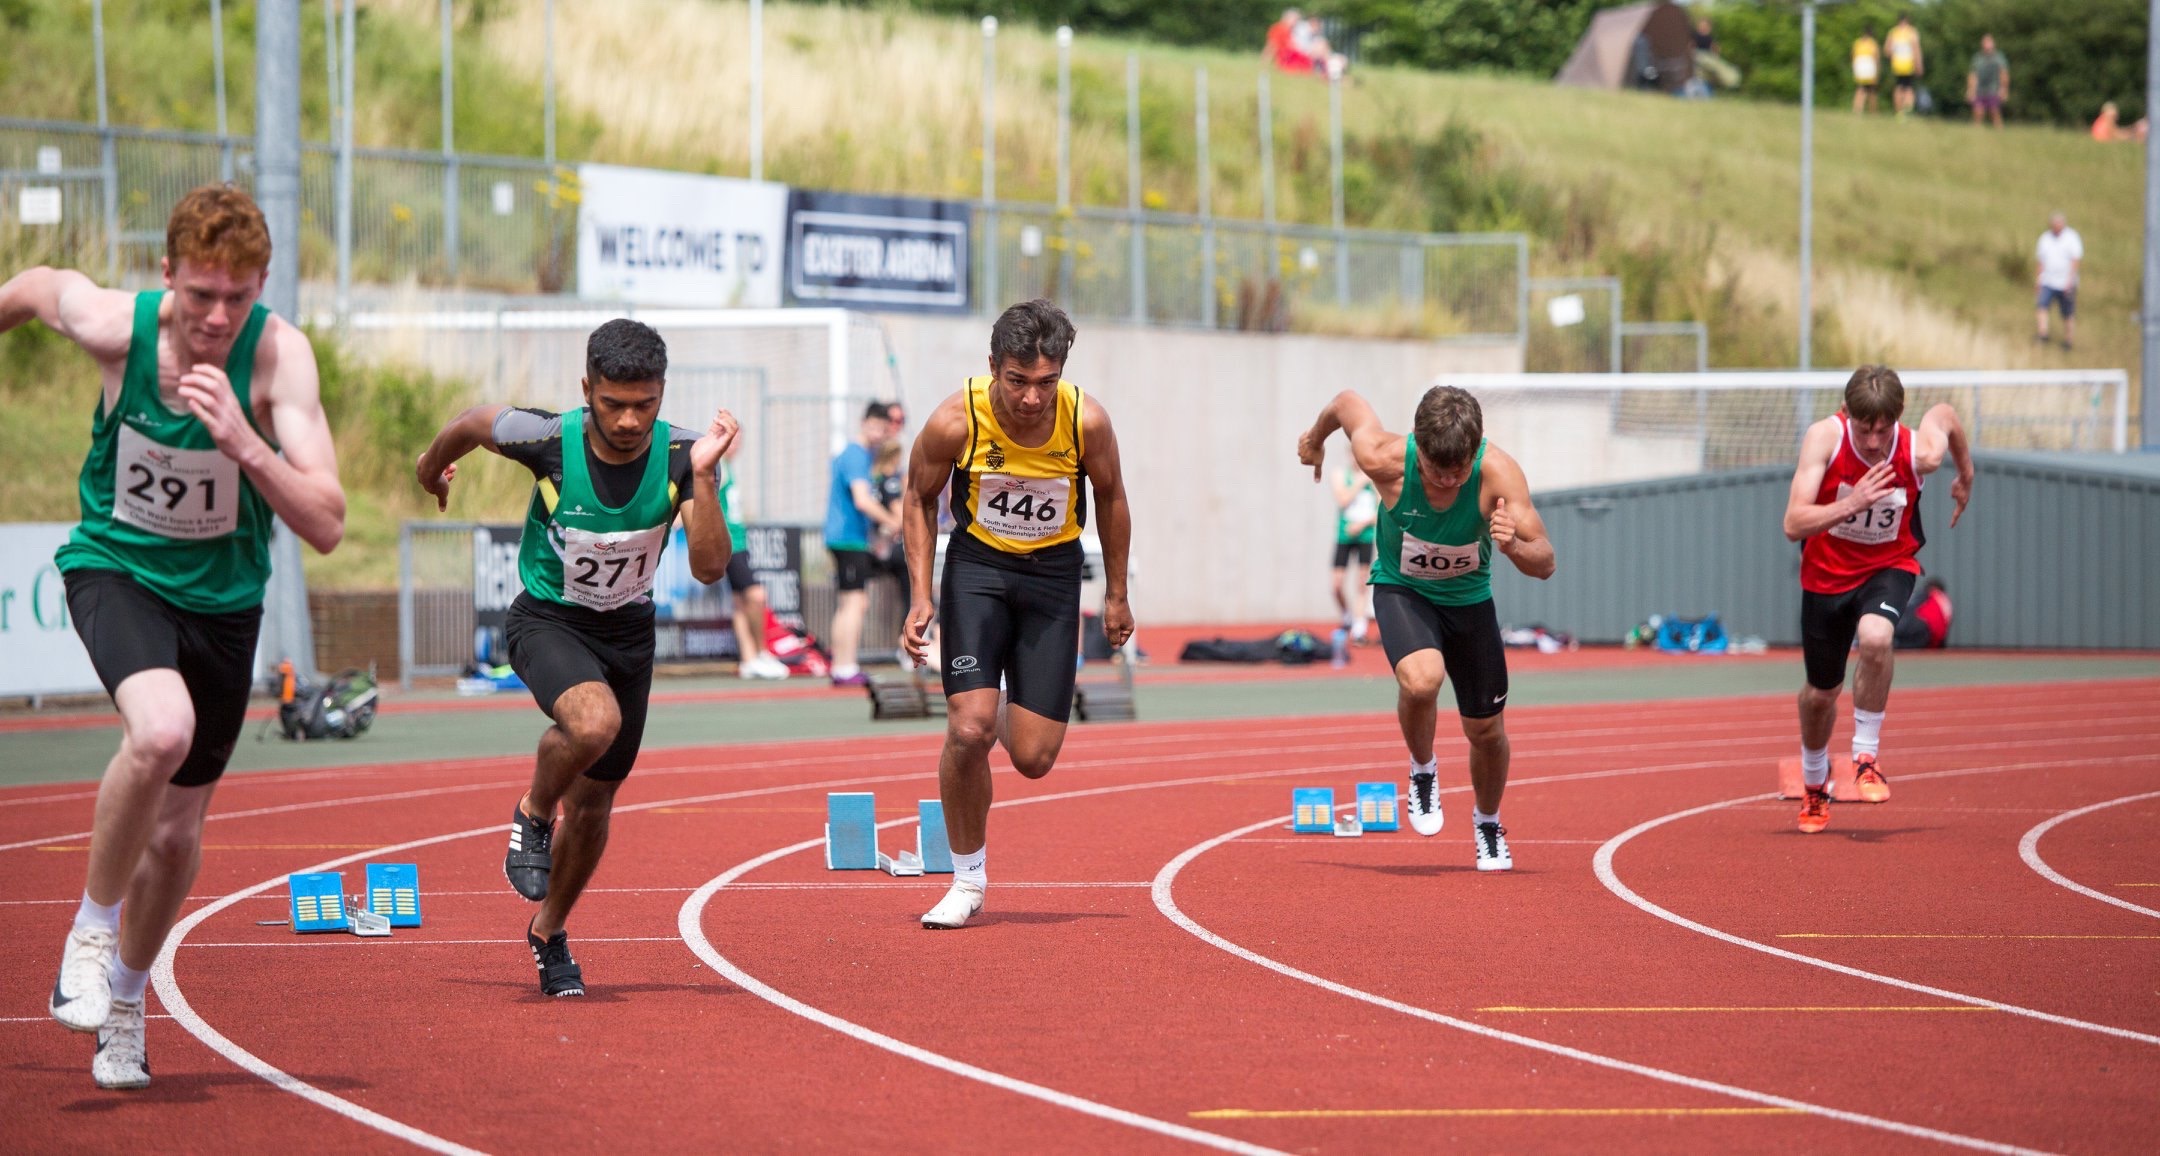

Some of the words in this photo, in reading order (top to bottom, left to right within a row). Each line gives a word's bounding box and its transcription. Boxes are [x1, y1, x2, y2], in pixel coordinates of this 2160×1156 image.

[596, 226, 724, 272] WELCOME
[735, 233, 768, 273] TO
[803, 233, 885, 277] EXETER
[885, 238, 955, 281] ARENA
[127, 463, 215, 511] 291
[987, 491, 1056, 522] 446
[983, 518, 1001, 526] South
[1002, 522, 1017, 530] West
[987, 525, 1037, 538] Championships
[573, 552, 648, 589] 271
[1408, 553, 1471, 570] 405
